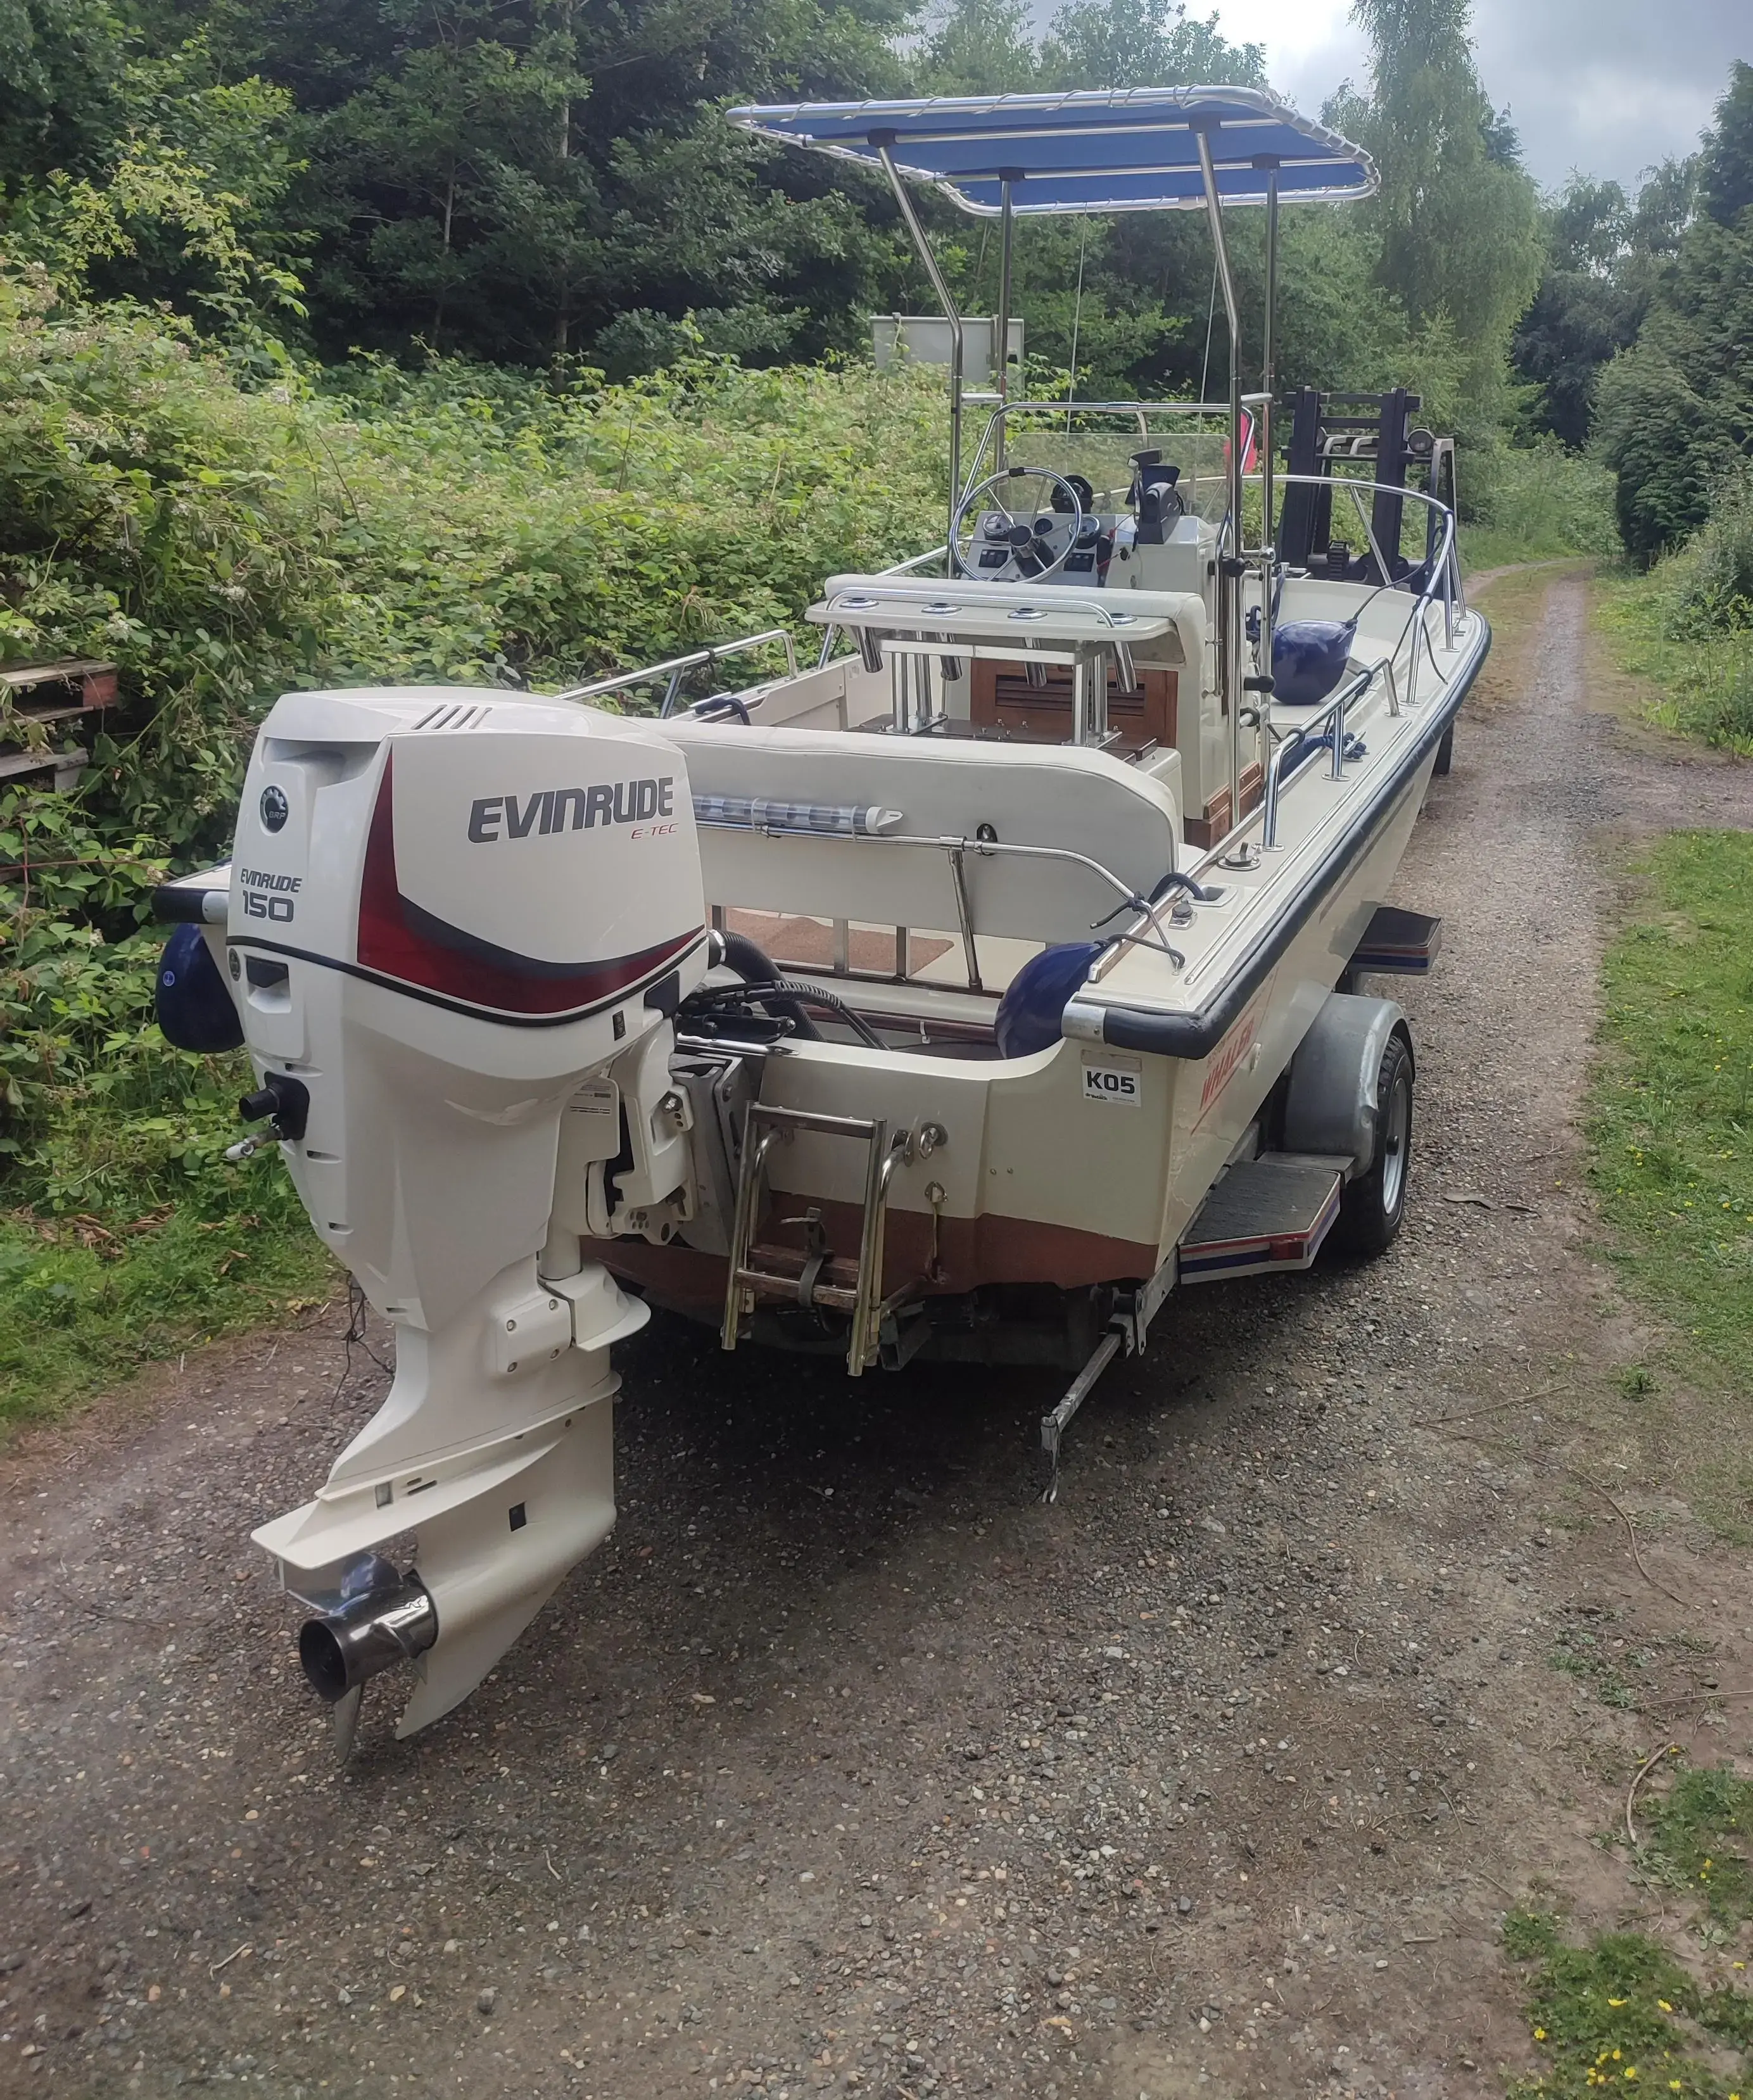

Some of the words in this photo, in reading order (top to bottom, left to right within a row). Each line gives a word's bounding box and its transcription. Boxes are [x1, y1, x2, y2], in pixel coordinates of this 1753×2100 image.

[269, 811, 287, 819] BRP
[468, 776, 673, 843] EVINRUDE
[631, 823, 679, 840] E-TEC
[241, 868, 303, 894] EVINRUDE
[243, 890, 294, 923] 150
